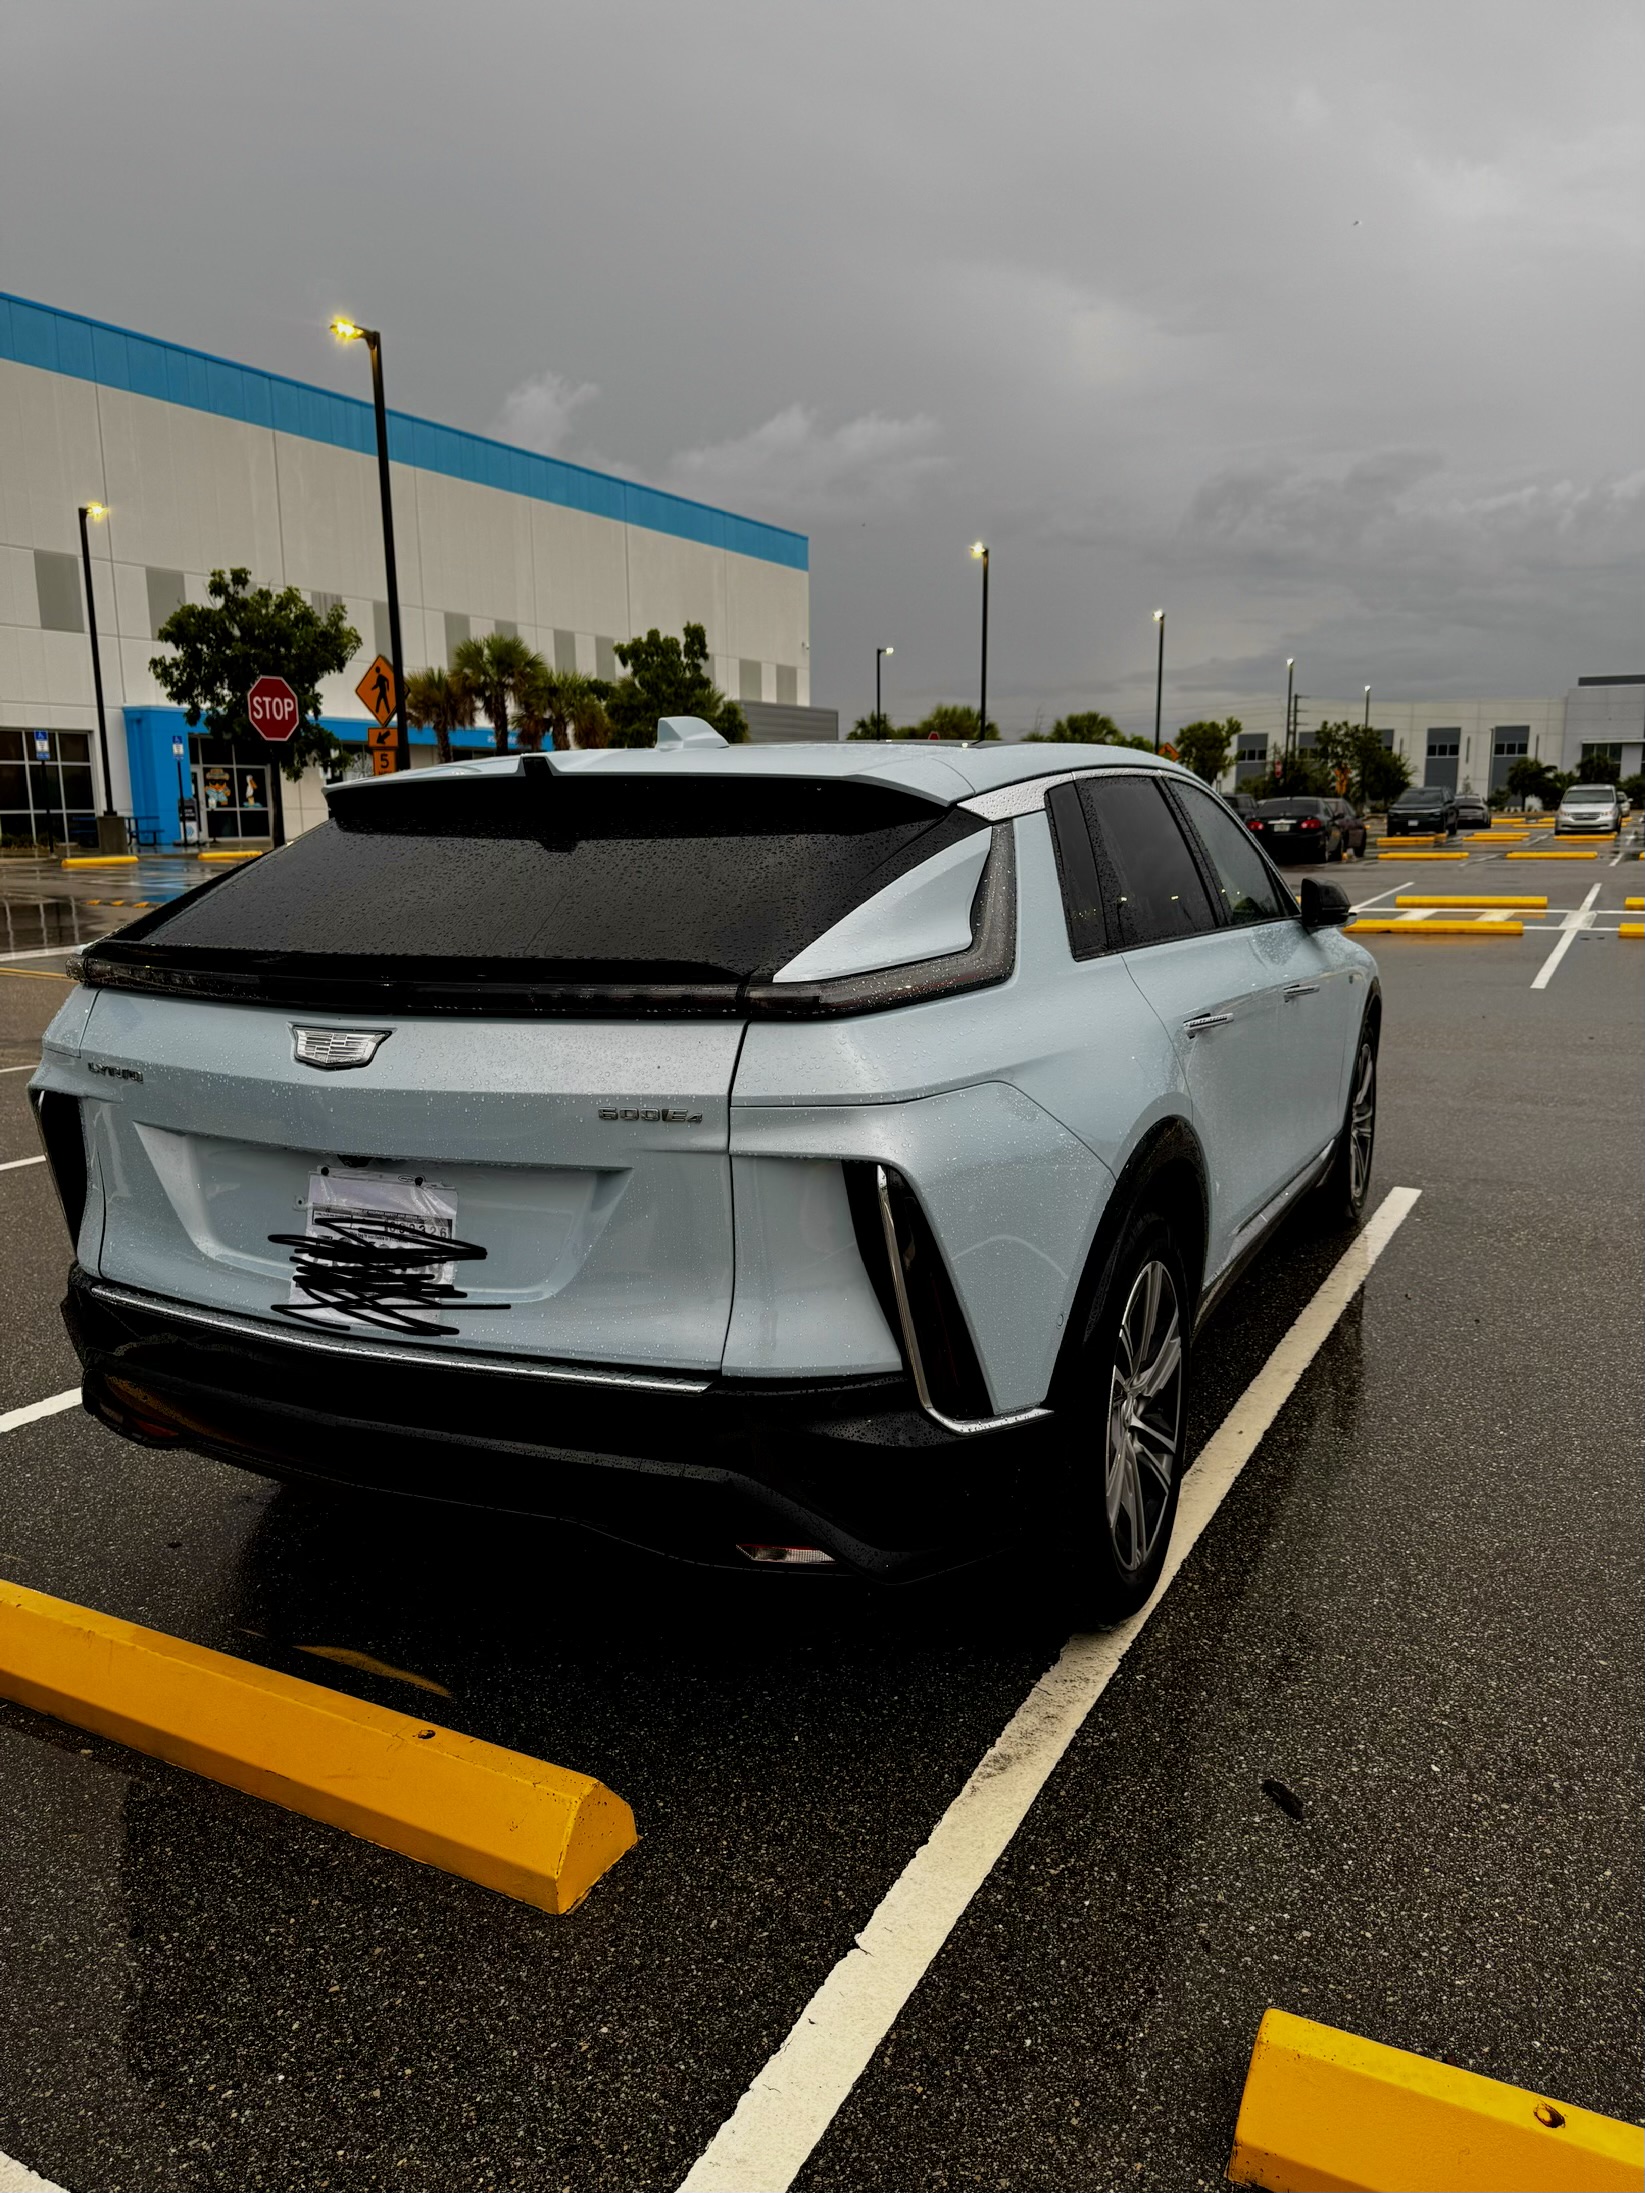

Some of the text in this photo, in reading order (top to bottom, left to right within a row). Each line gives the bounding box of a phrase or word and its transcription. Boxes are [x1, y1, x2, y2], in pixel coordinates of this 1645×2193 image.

[253, 696, 294, 720] STOP
[380, 753, 389, 769] 5
[598, 1107, 703, 1123] 600E4
